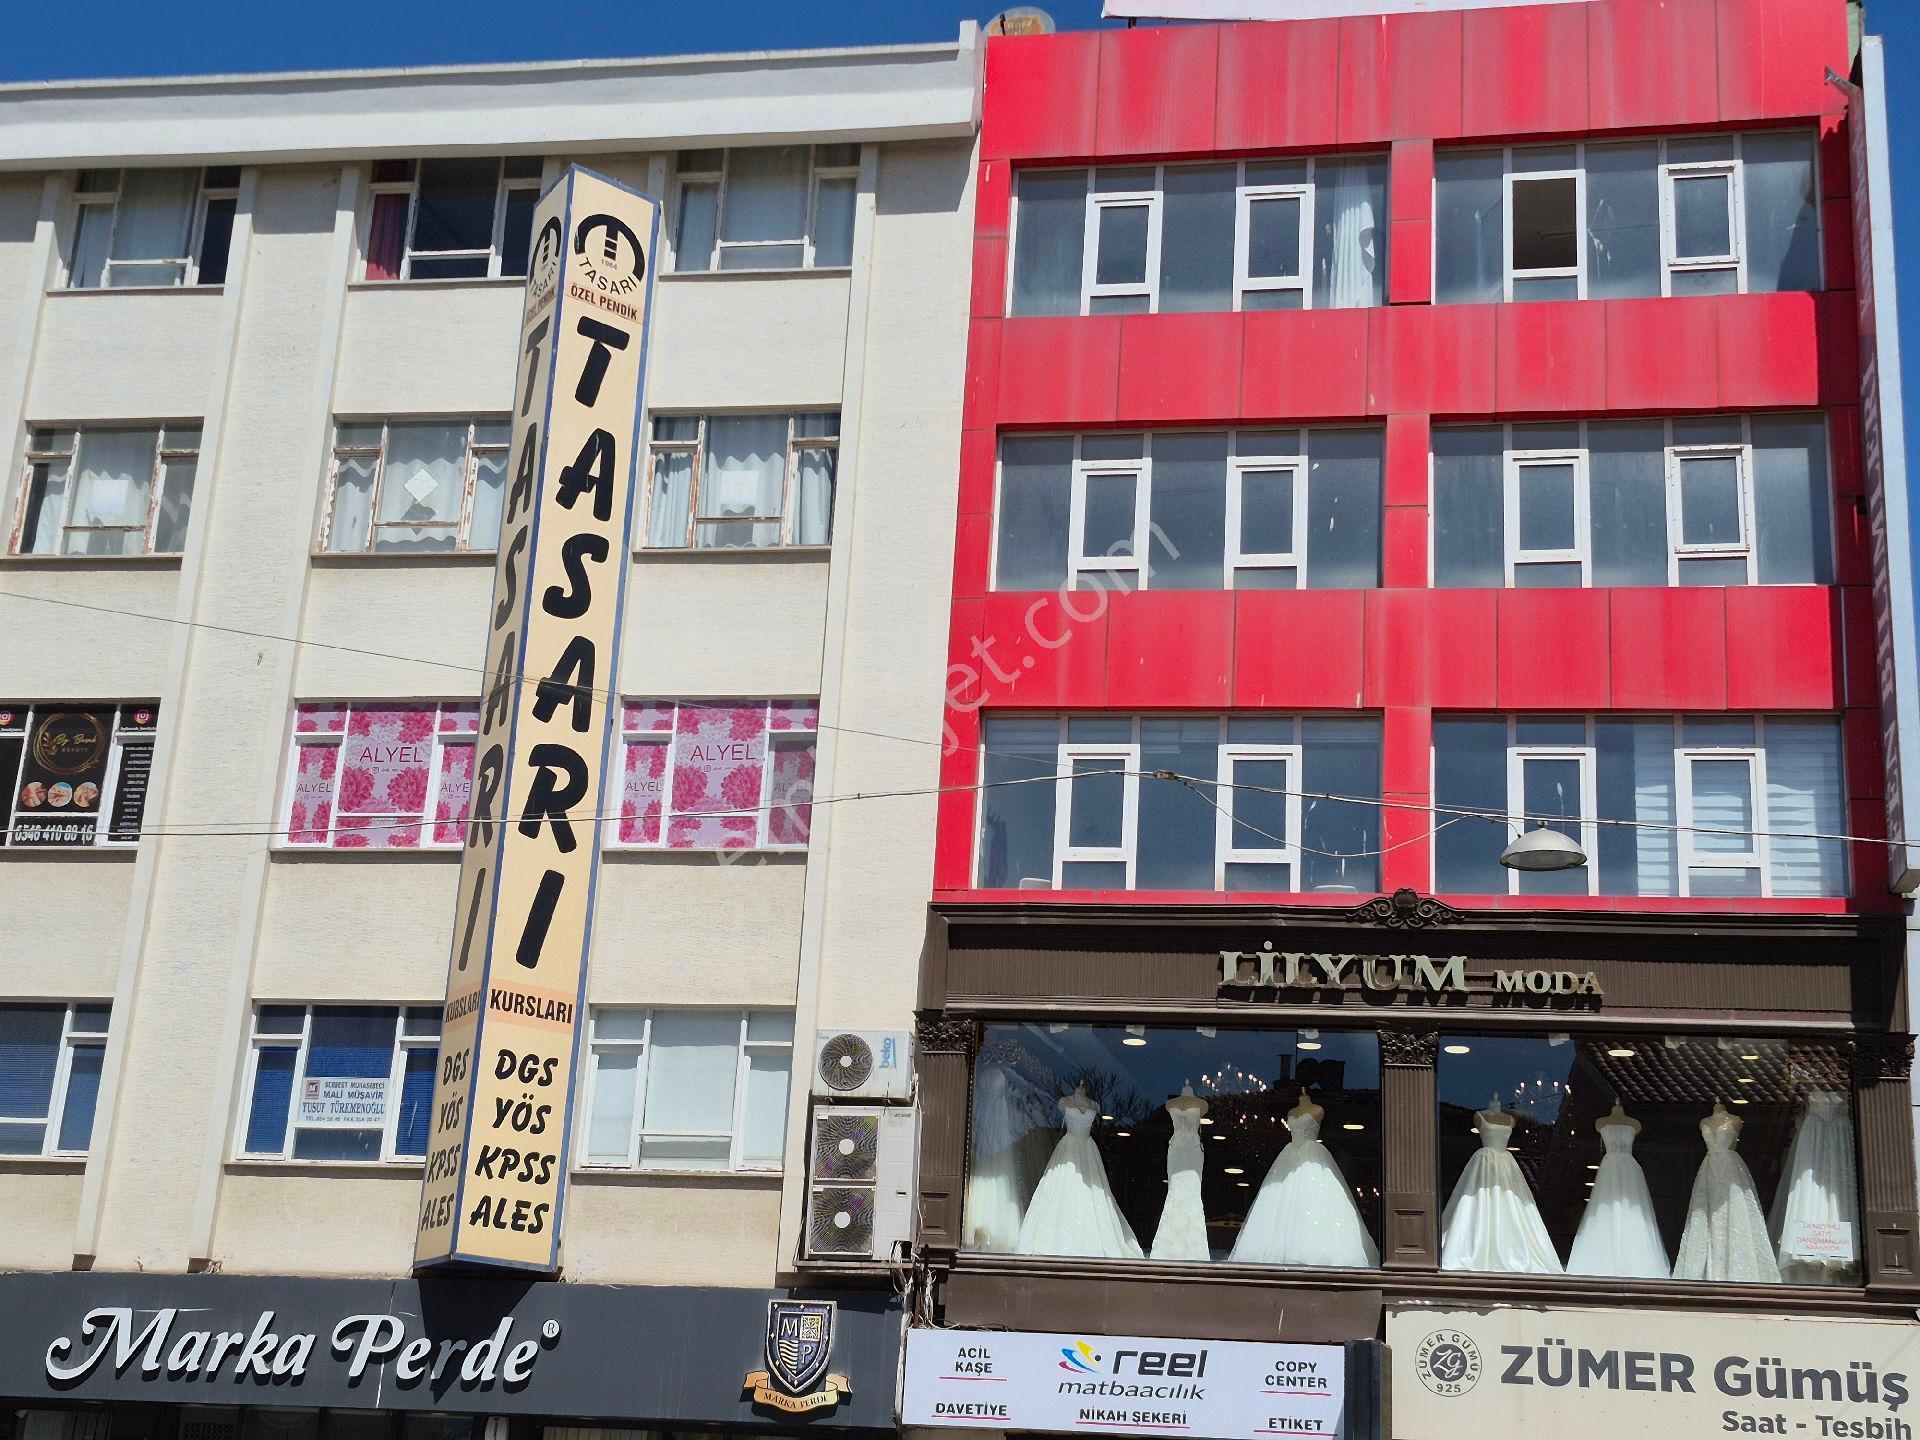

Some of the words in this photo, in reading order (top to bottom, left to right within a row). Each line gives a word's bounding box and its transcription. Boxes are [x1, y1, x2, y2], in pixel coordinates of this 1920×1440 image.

[578, 257, 638, 296] TASARI
[570, 282, 596, 306] ÖZEL
[599, 295, 638, 321] PENDİK
[458, 315, 551, 972] TASARI
[515, 315, 631, 969] TASARI
[359, 746, 423, 763] ALYEL
[690, 743, 755, 762] ALYEL
[296, 782, 333, 793] ALYEL
[440, 782, 470, 793] ALYE
[624, 781, 662, 793] ALYEL
[1219, 940, 1468, 993] LİLYUM
[1493, 969, 1604, 995] MODA
[445, 990, 481, 1024] KURSLARI
[489, 988, 573, 1024] KURSLARI
[879, 1036, 892, 1069] beko
[442, 1048, 470, 1087] DGS
[494, 1048, 559, 1087] DGS
[323, 1090, 343, 1099] MALİ
[347, 1090, 384, 1100] MÜŞAVİR
[324, 1081, 349, 1089] SERBEST
[302, 1101, 326, 1114] YUSUF
[438, 1092, 464, 1134] YÖS
[491, 1093, 552, 1135] YÖS
[427, 1143, 461, 1184] KPSS
[474, 1144, 557, 1185] KPSS
[420, 1192, 455, 1232] ALES
[468, 1194, 550, 1235] ALES
[780, 1318, 799, 1337] M
[45, 1307, 315, 1381] Marka
[332, 1314, 538, 1382] Perde
[801, 1344, 812, 1363] P
[957, 1345, 991, 1359] ACİL
[954, 1361, 993, 1376] KAŞE
[1112, 1350, 1208, 1378] reel
[1275, 1360, 1318, 1374] COPY
[1501, 1337, 1696, 1393] ZÜMER
[1714, 1356, 1910, 1412] Gümüş
[1058, 1381, 1206, 1400] matbaacılık
[1264, 1374, 1327, 1388] CENTER
[1436, 1383, 1461, 1393] 925
[763, 1392, 797, 1409] MARKA
[799, 1394, 828, 1409] PERDE
[935, 1401, 1008, 1416] DAVETİYE
[1079, 1405, 1127, 1421] NİKAH
[1132, 1410, 1187, 1425] ŞEKERİ
[1268, 1416, 1323, 1431] ETİKET
[1722, 1410, 1788, 1434] Saat
[1815, 1415, 1912, 1440] Tesbih
